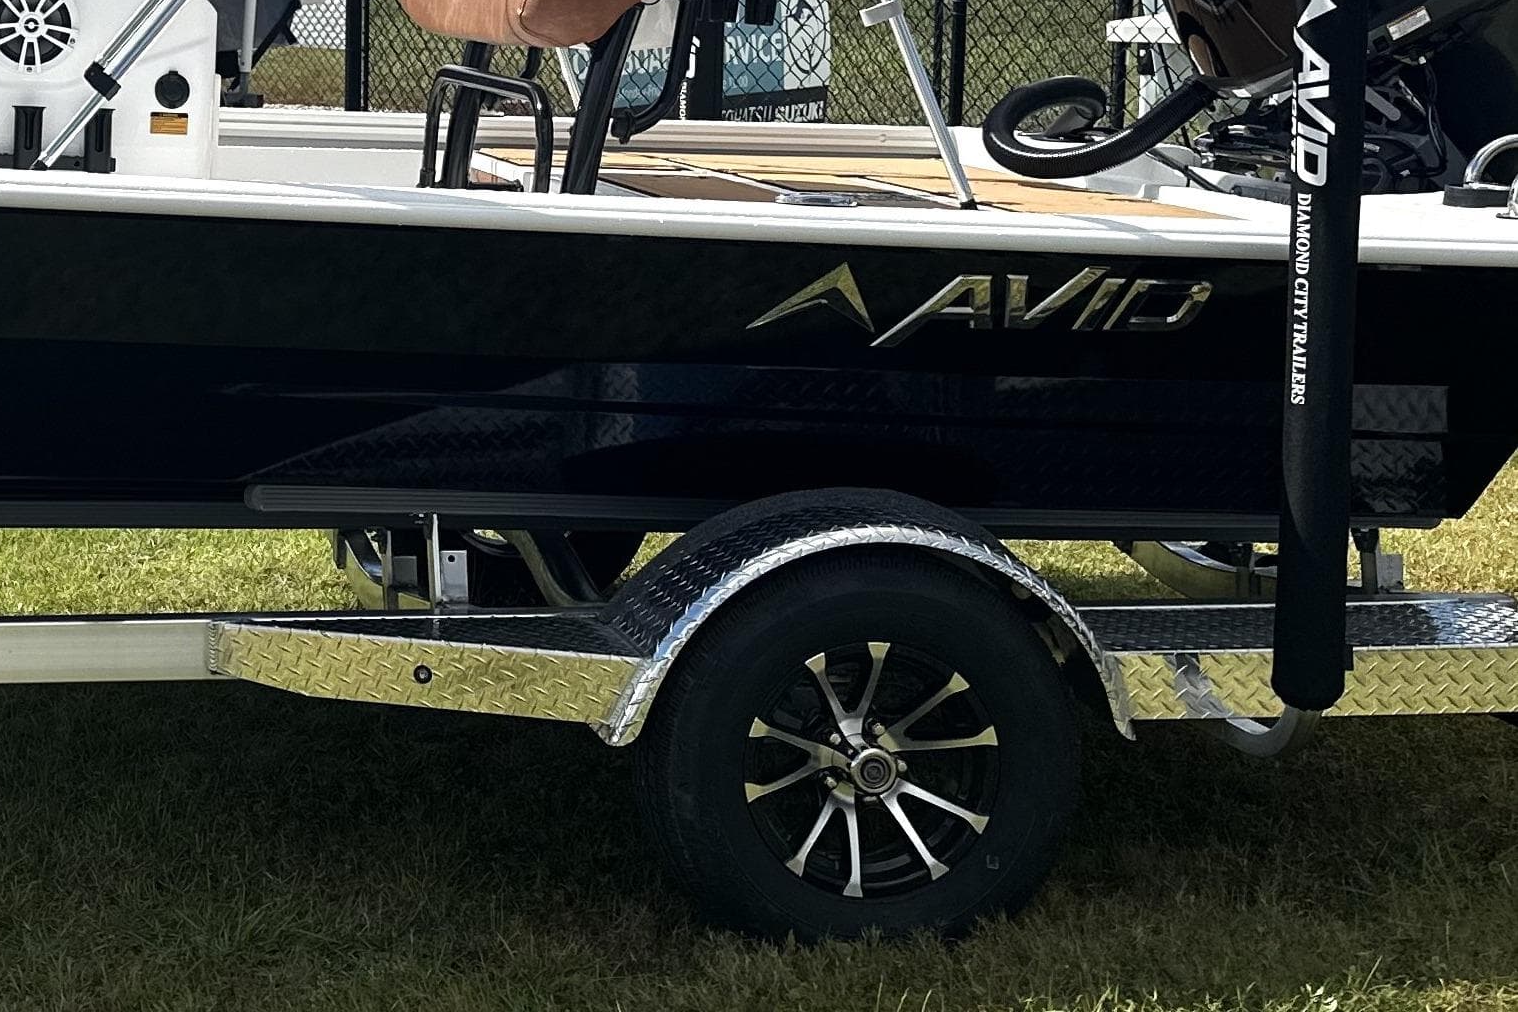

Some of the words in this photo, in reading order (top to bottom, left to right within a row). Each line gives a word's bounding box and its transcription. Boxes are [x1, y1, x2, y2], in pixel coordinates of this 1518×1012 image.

[1293, 26, 1336, 187] AVID
[1294, 192, 1313, 275] DIAMOND
[868, 265, 1213, 347] AVID
[1292, 277, 1310, 320] CITY
[1290, 321, 1309, 405] TRAILERS
